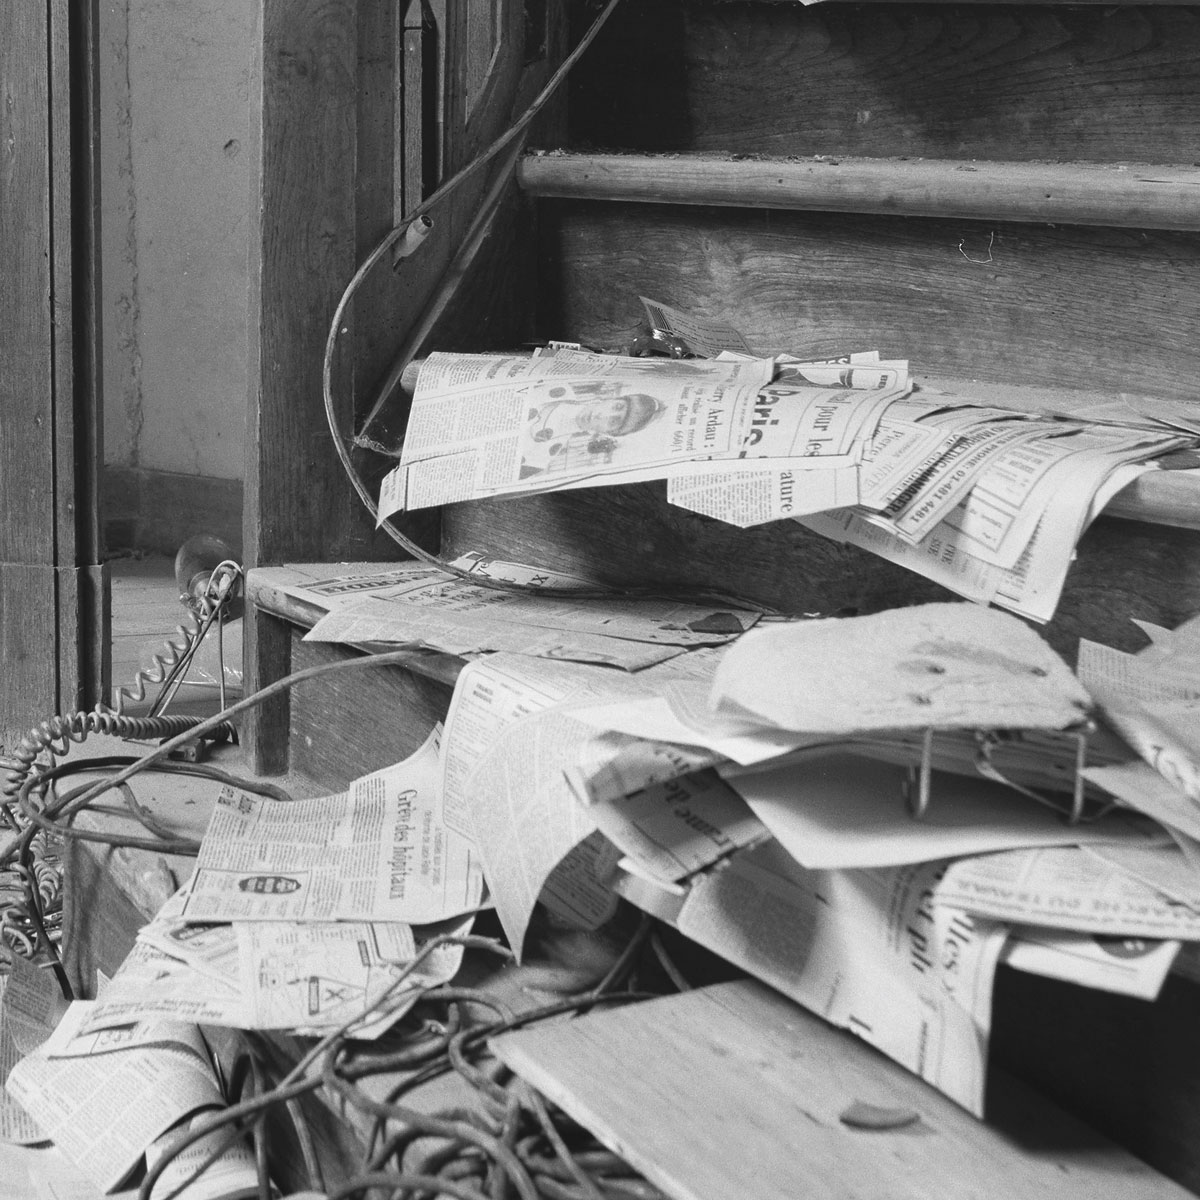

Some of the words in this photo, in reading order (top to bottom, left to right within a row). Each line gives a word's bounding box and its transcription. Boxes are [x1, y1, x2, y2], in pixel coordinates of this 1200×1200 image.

[812, 405, 839, 430] pour
[803, 437, 834, 458] les
[779, 469, 796, 513] ature
[394, 824, 416, 842] des
